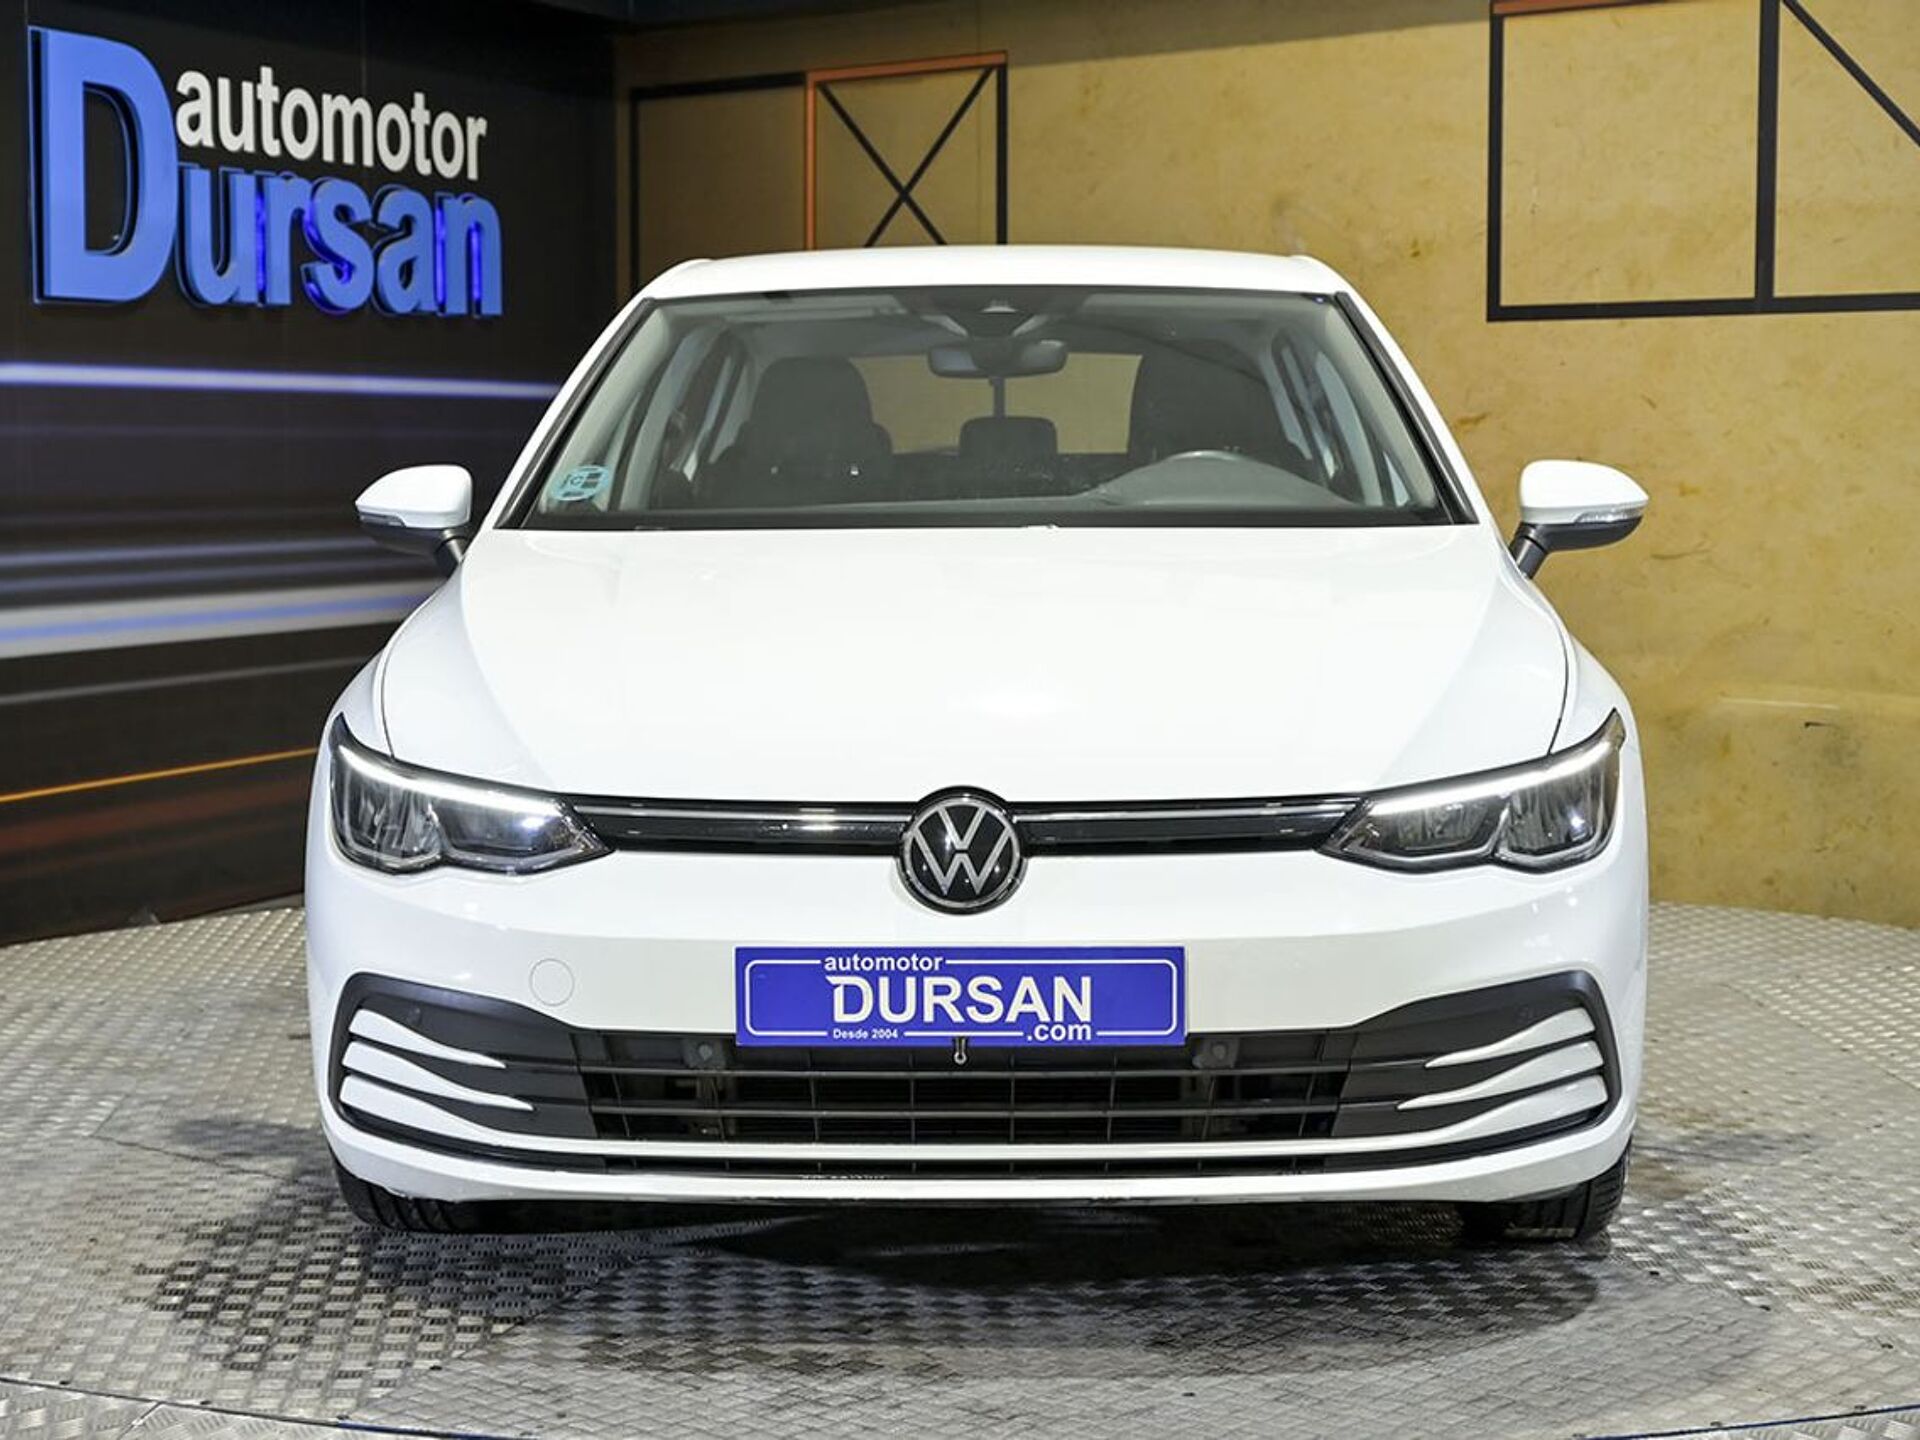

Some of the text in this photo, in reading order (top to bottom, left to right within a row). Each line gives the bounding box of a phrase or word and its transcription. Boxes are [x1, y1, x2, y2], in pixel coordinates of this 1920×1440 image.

[176, 66, 487, 180] automotor
[28, 25, 502, 317] Dursan
[825, 953, 943, 971] automotor
[826, 976, 1092, 1023] DURSAN
[833, 1029, 899, 1039] Desde 2004
[1026, 1023, 1092, 1041] .com
